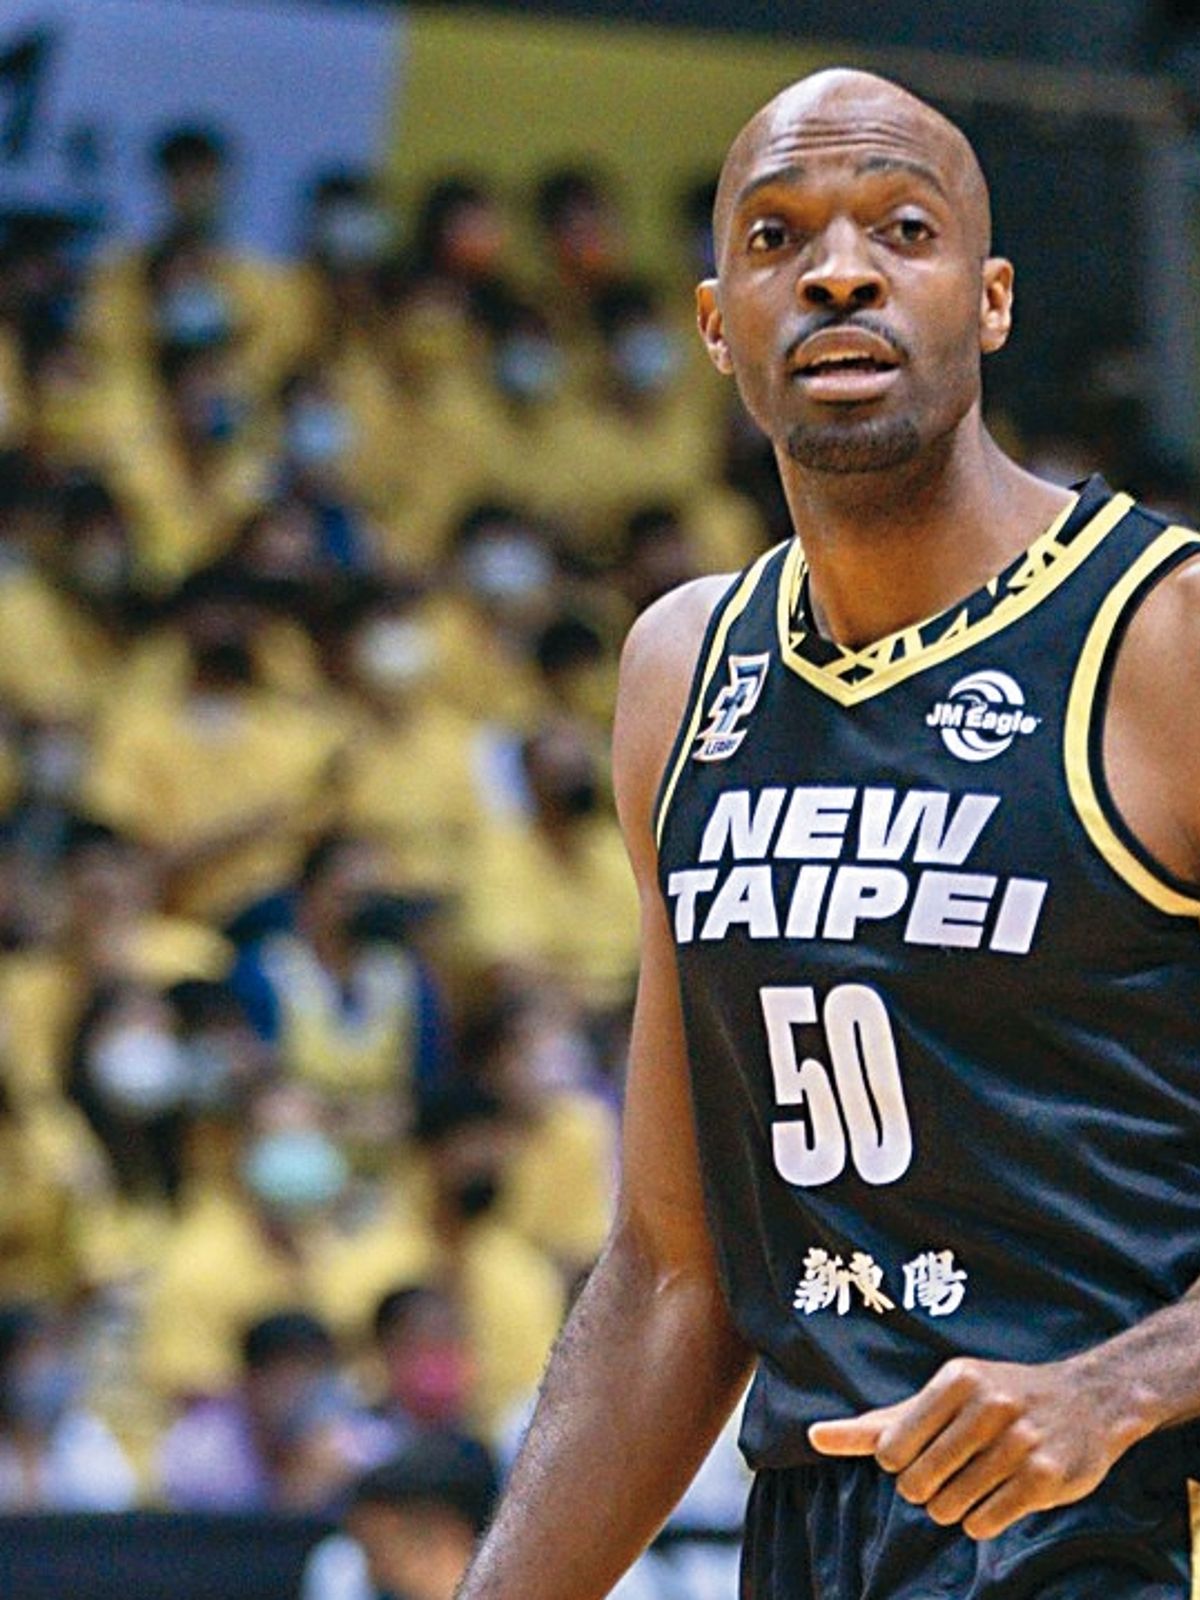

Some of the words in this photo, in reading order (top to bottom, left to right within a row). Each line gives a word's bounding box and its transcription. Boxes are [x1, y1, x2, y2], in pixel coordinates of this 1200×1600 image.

[926, 703, 965, 728] JM
[965, 702, 1037, 736] Eagle
[699, 786, 1001, 865] NEW
[668, 864, 1048, 954] TAIPEI
[759, 983, 912, 1187] 50
[793, 1247, 968, 1317] 新東陽
